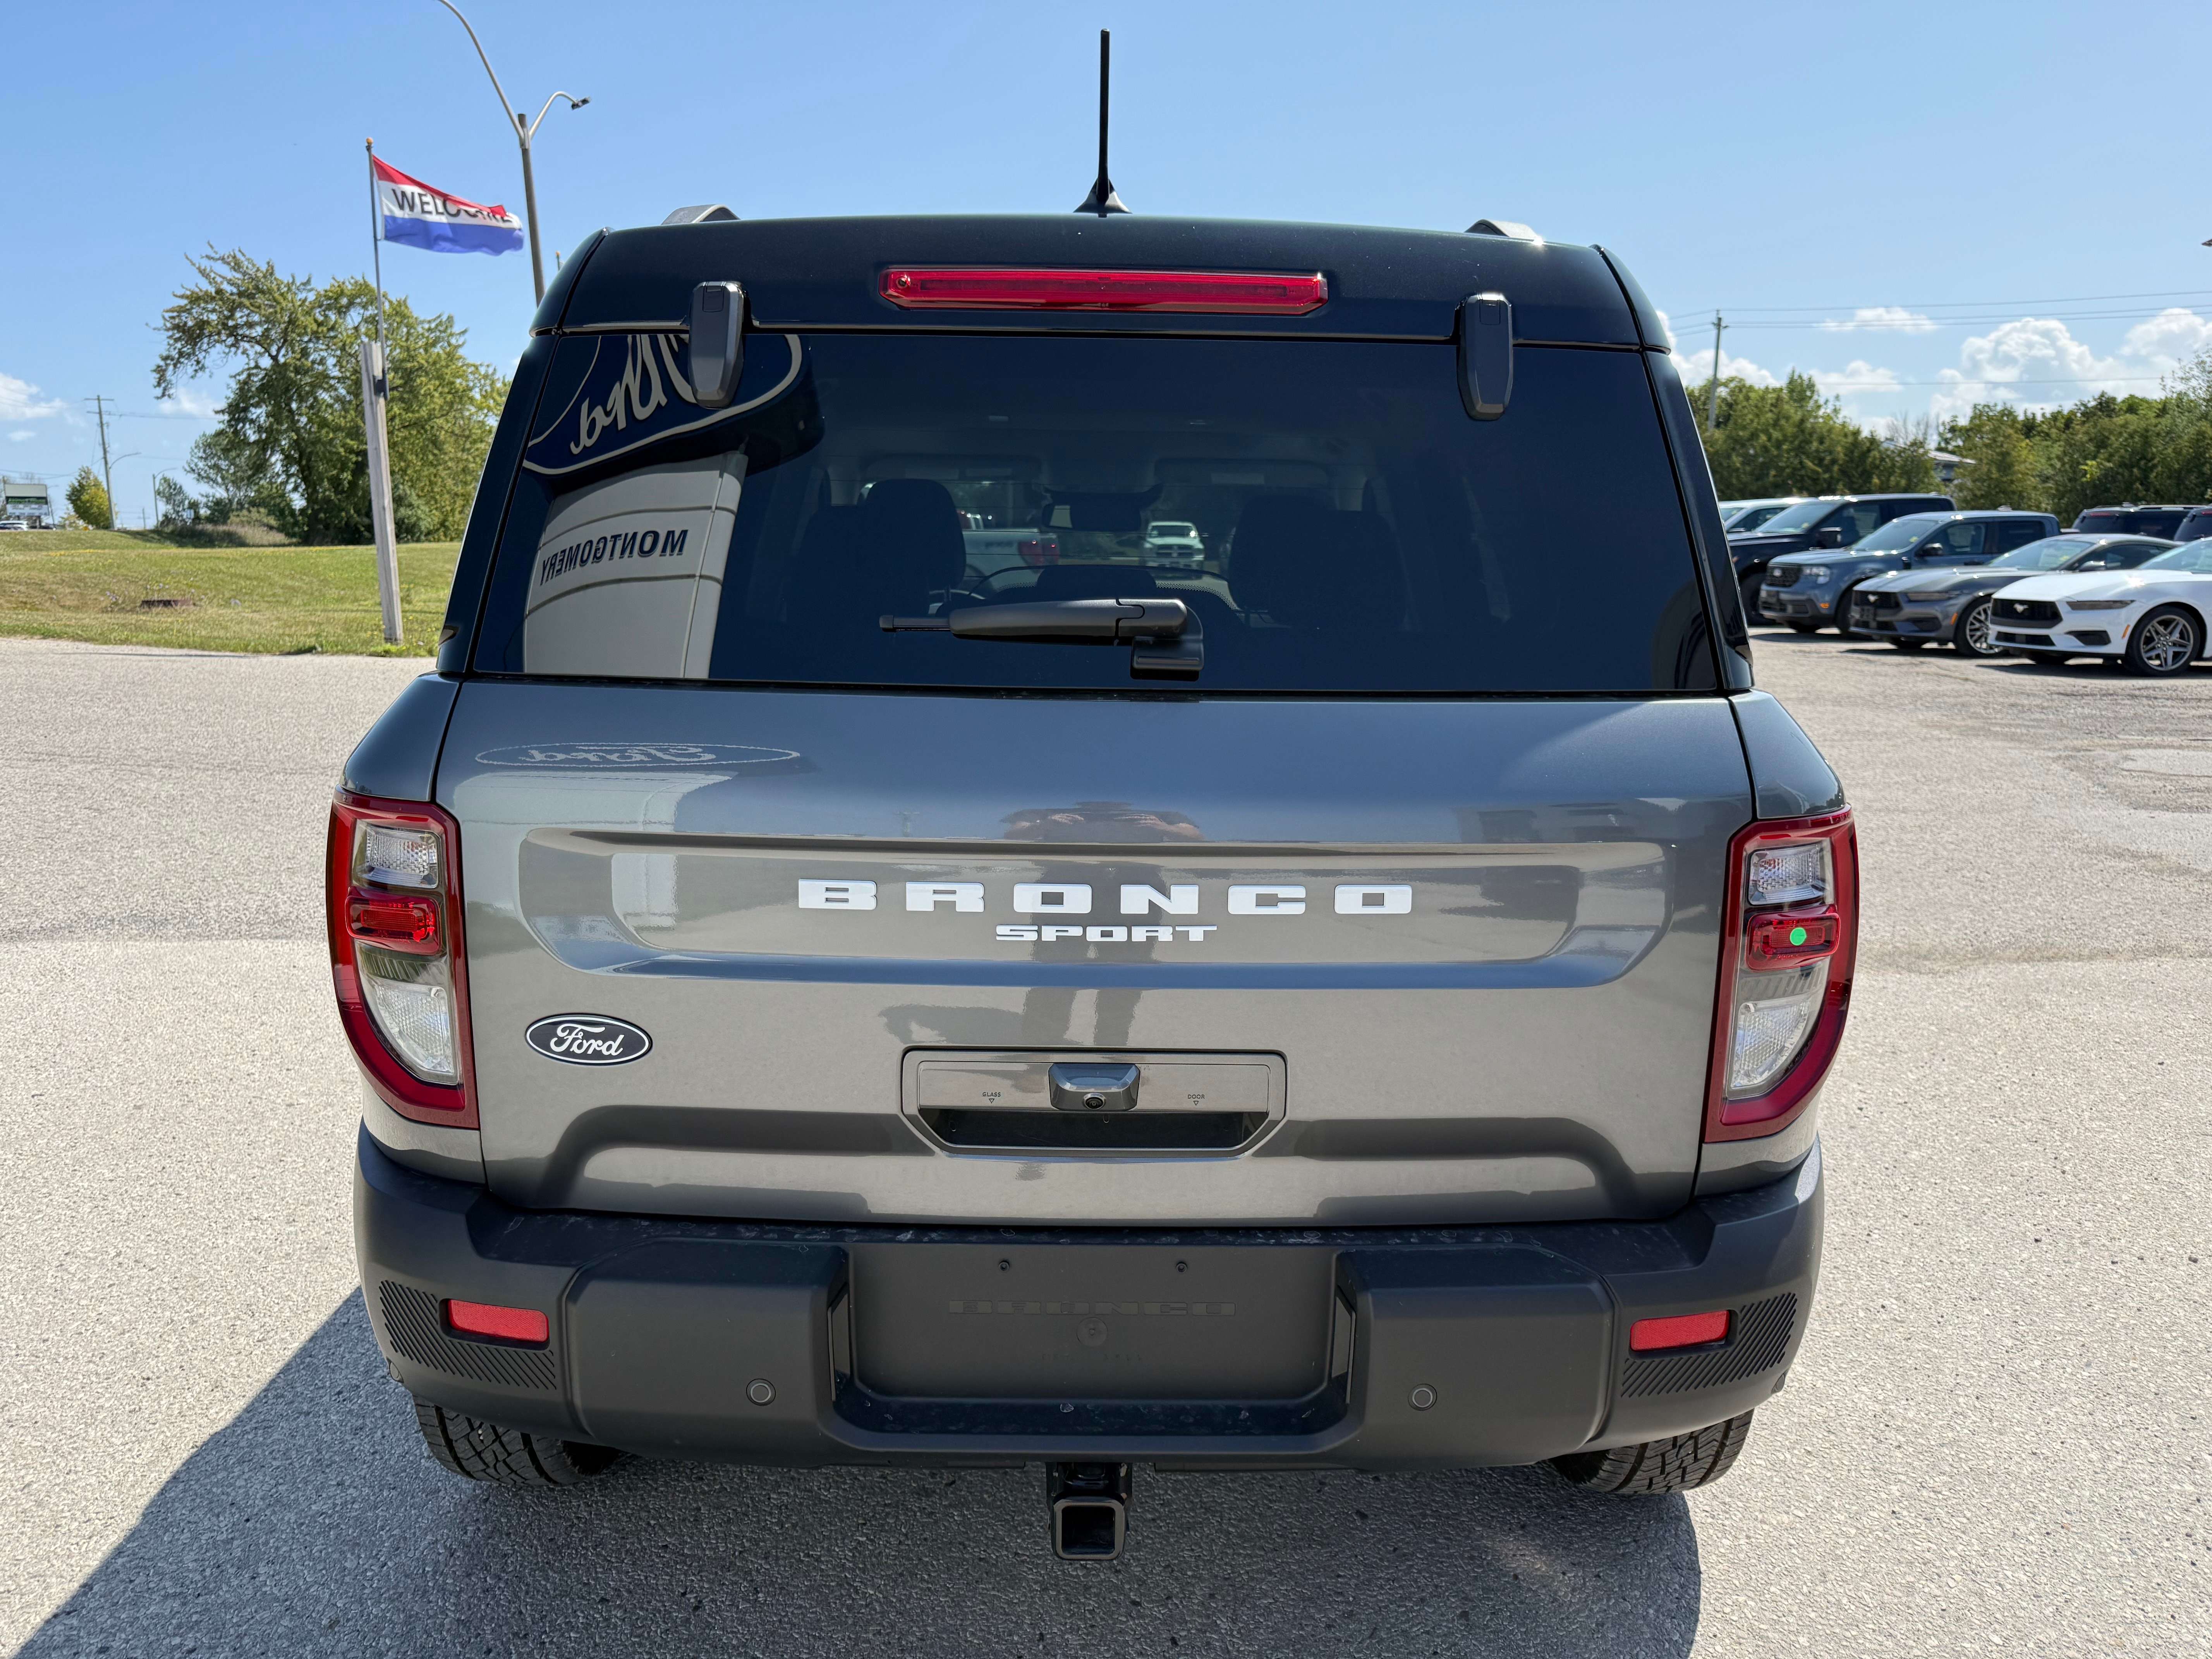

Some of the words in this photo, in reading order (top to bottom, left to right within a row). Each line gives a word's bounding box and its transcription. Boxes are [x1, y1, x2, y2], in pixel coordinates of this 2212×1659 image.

[798, 878, 1412, 915] BRONCO
[996, 924, 1217, 942] SPORT
[550, 1023, 625, 1056] Ford
[949, 1300, 1236, 1316] BRONCO
